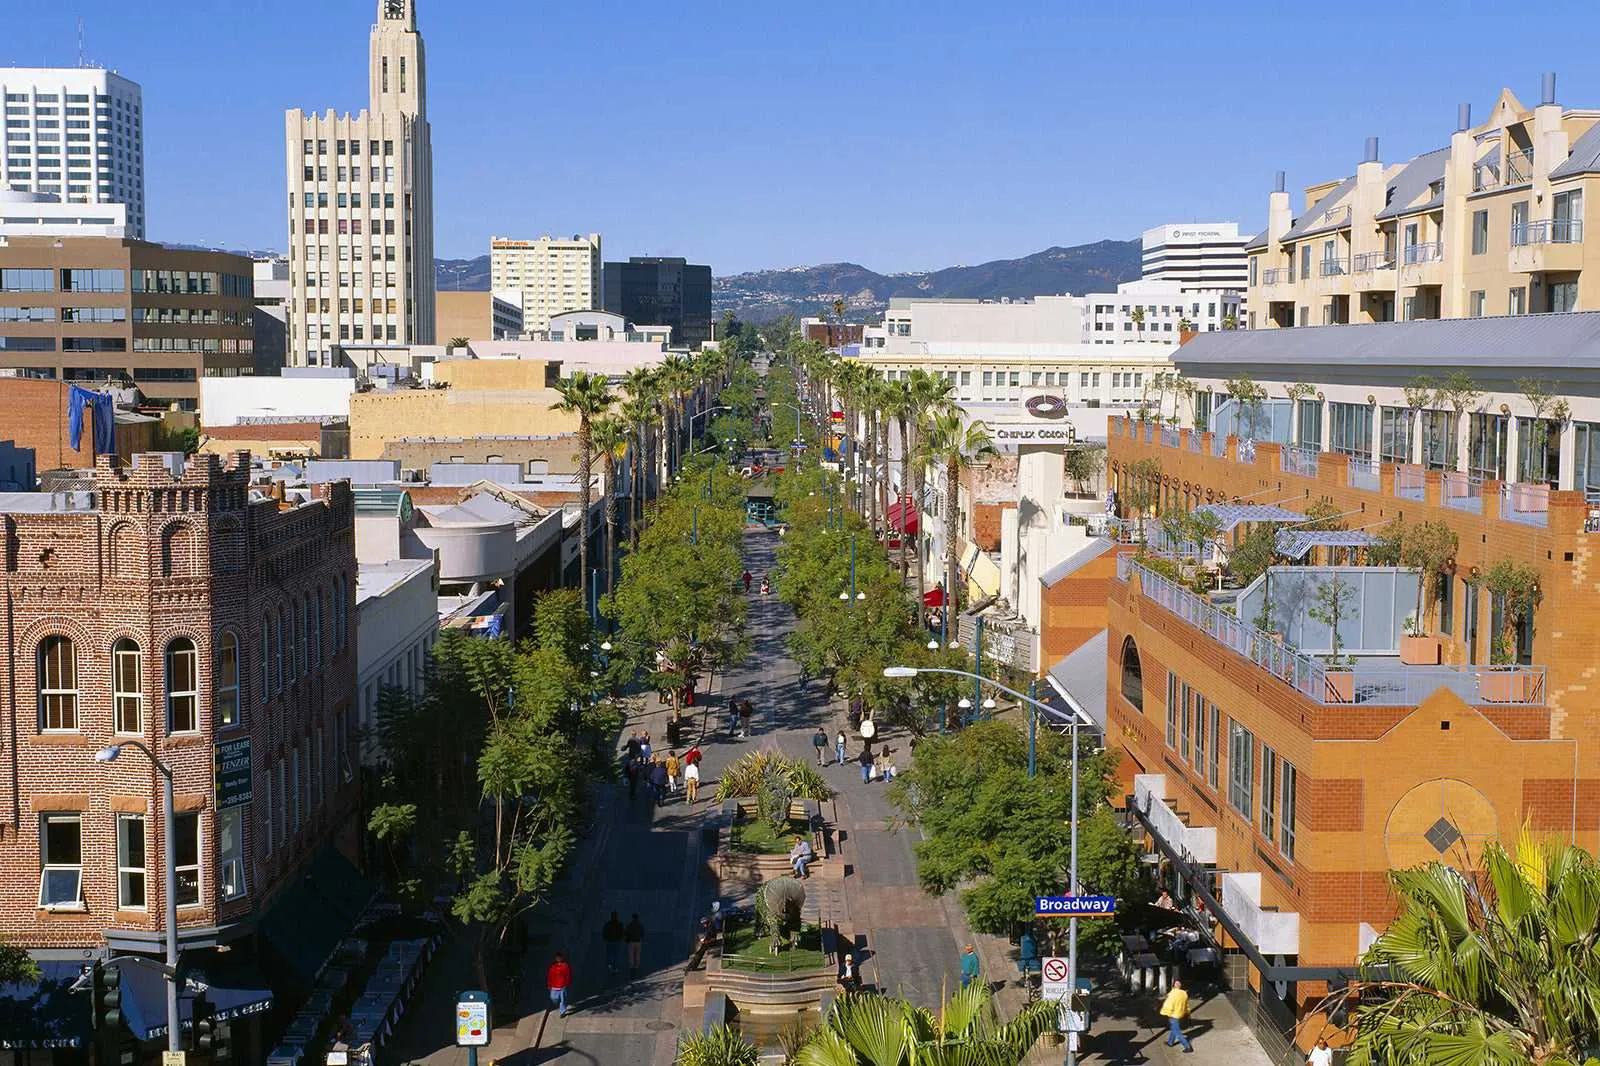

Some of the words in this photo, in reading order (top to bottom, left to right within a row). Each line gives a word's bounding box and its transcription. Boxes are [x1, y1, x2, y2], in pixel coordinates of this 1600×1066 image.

[997, 429, 1035, 439] CINEPLEX
[1037, 429, 1069, 439] ODEON
[233, 739, 250, 750] LEASE
[1039, 898, 1110, 912] Broadway
